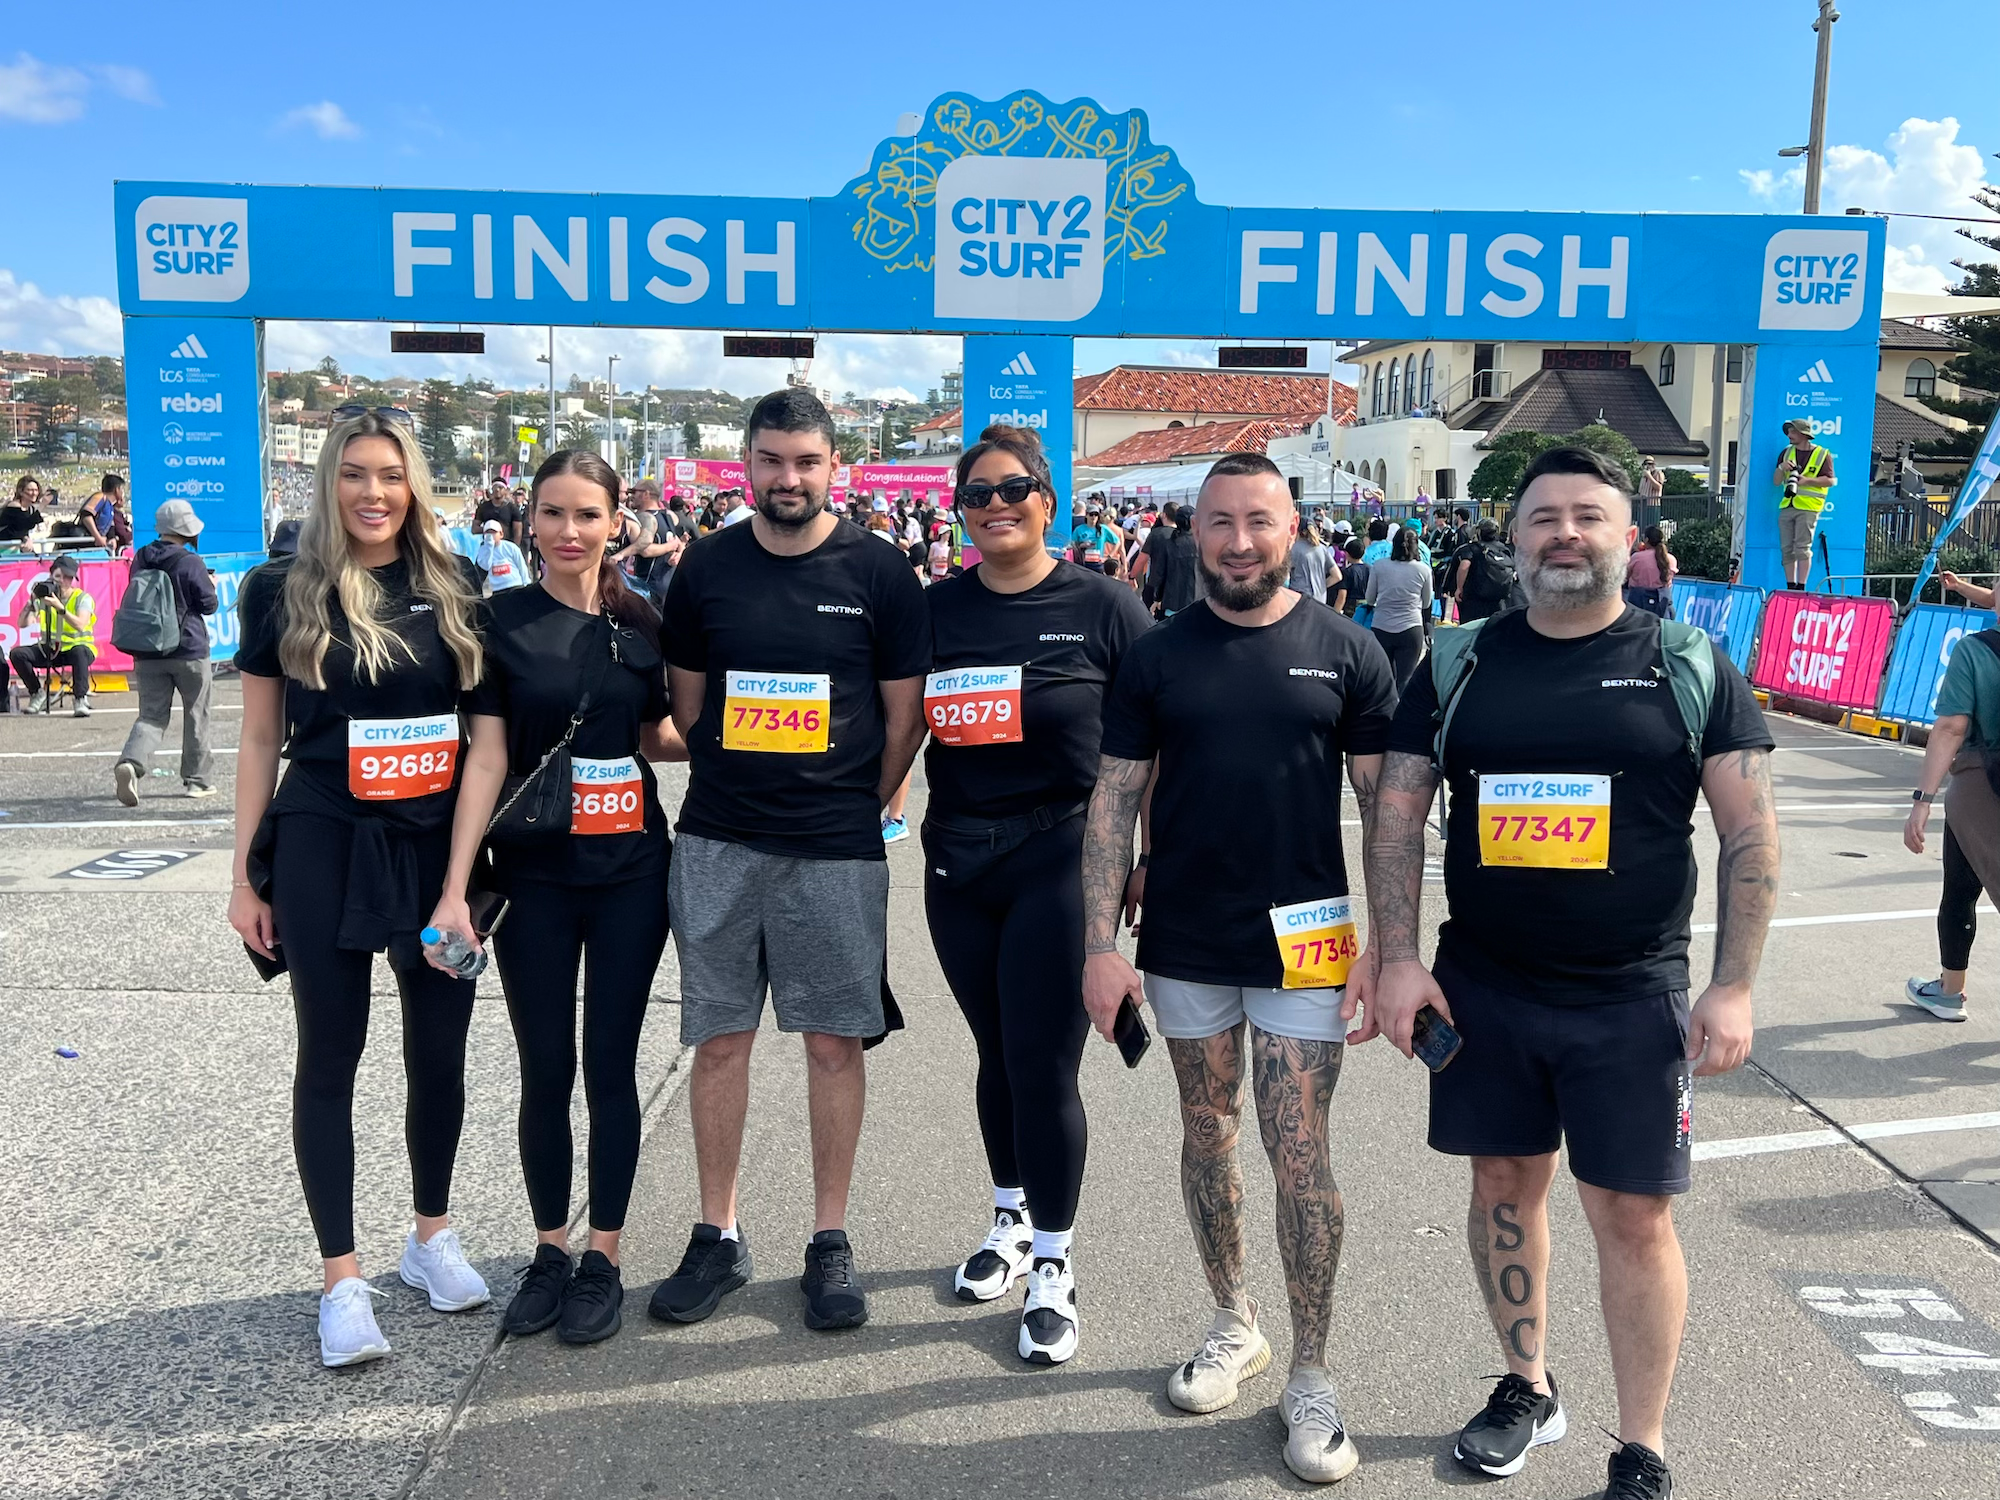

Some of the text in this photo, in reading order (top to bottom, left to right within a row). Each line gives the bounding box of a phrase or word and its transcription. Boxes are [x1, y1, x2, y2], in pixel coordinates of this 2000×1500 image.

[951, 195, 1091, 239] CITY2
[146, 222, 239, 249] CITY2
[153, 251, 234, 275] SURF
[392, 212, 796, 306] FINISH
[958, 240, 1083, 279] SURF
[1774, 253, 1858, 280] CITY2
[1239, 230, 1629, 319] FINISH
[1776, 282, 1852, 305] SURF
[160, 368, 184, 383] tcs
[161, 392, 222, 413] rebel
[989, 384, 1012, 399] tcs
[1786, 391, 1809, 406] tcs
[185, 456, 226, 466] GWM
[863, 471, 947, 484] Congratulations!
[1039, 633, 1085, 642] BENTINO
[1792, 608, 1856, 653] CITY2
[1288, 668, 1338, 679] BENTINO
[1786, 649, 1845, 691] SURF
[733, 707, 820, 731] 77346
[932, 699, 1012, 728] 92679
[360, 750, 449, 780] 92682
[1490, 816, 1597, 843] 77347
[1291, 934, 1357, 969] 77345
